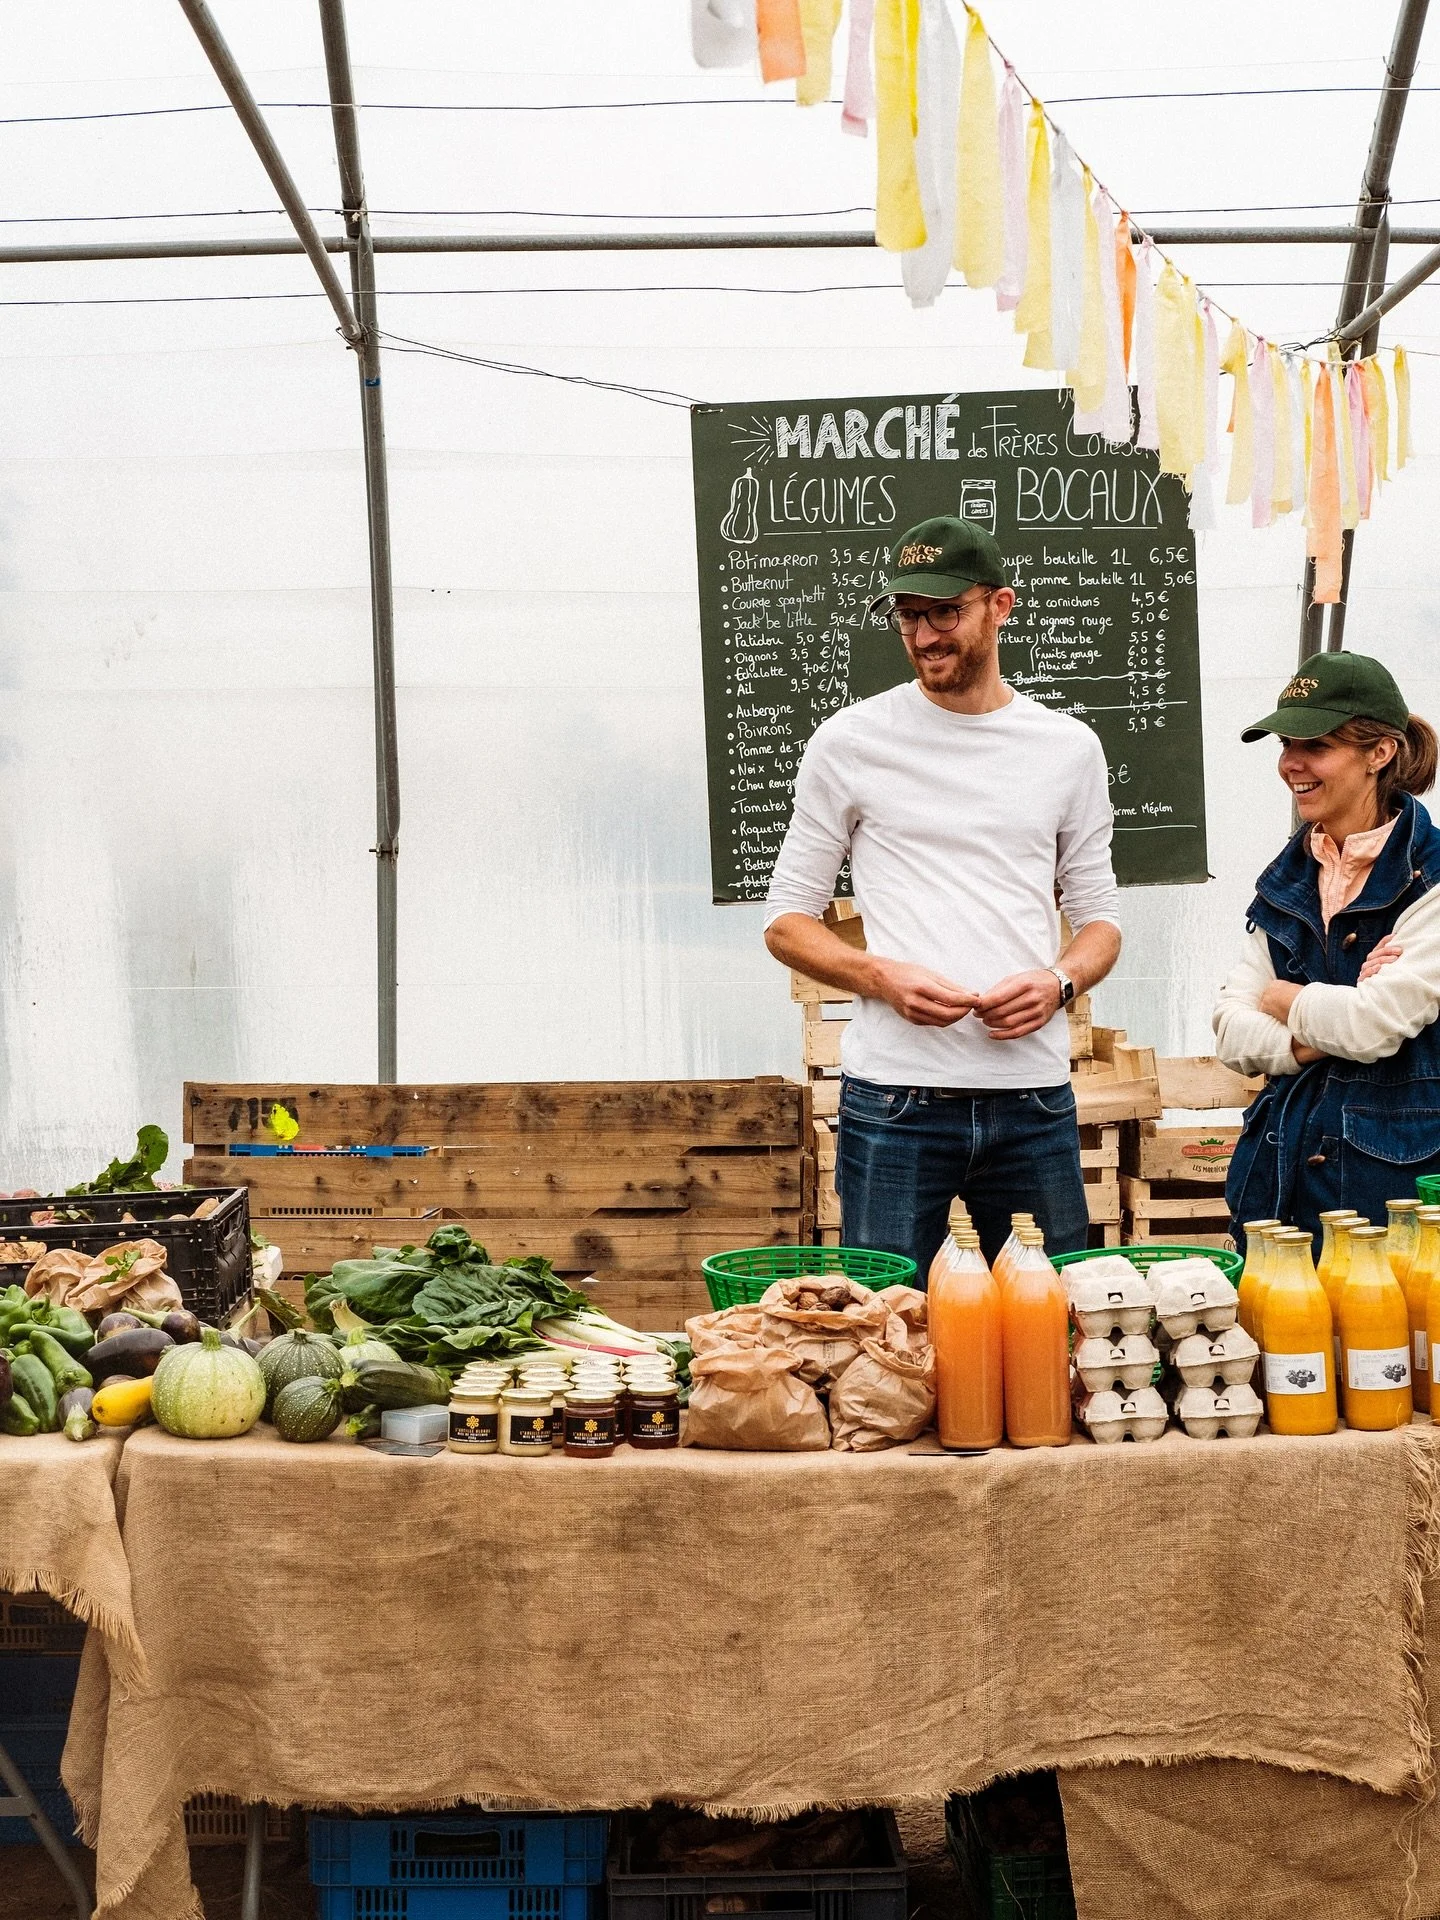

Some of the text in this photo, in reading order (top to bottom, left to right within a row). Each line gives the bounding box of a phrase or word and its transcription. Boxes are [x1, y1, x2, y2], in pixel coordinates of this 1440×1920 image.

[776, 393, 960, 460] MARCHÉ
[968, 432, 988, 458] des
[981, 405, 1059, 458] FRÈRES
[770, 472, 897, 525] LÉGUMES
[1017, 467, 1163, 525] BOCAUX
[728, 550, 819, 570] Potimarron
[830, 548, 852, 566] 3,5
[731, 569, 794, 593] Butternut
[1012, 572, 1026, 587] de
[1030, 576, 1071, 592] pomme
[732, 597, 771, 619] Courge
[776, 584, 826, 613] spaghetti
[1028, 597, 1041, 608] de
[1046, 597, 1100, 608] cornichons
[733, 614, 760, 630] Jack
[766, 612, 781, 629] be
[787, 610, 817, 627] little
[1082, 617, 1113, 635] rouge
[1041, 632, 1094, 644] Rhubarbe
[734, 651, 778, 672] Oignons
[1038, 660, 1078, 671] Abricot
[1070, 650, 1102, 664] rouge
[736, 704, 795, 723] Aubergine
[737, 721, 792, 738] Poivrons
[736, 742, 774, 759] Pomme
[780, 742, 793, 753] de
[738, 763, 765, 776] Noix
[738, 779, 764, 791] Chou
[734, 798, 787, 814] Tomates
[740, 821, 789, 841] Roquette
